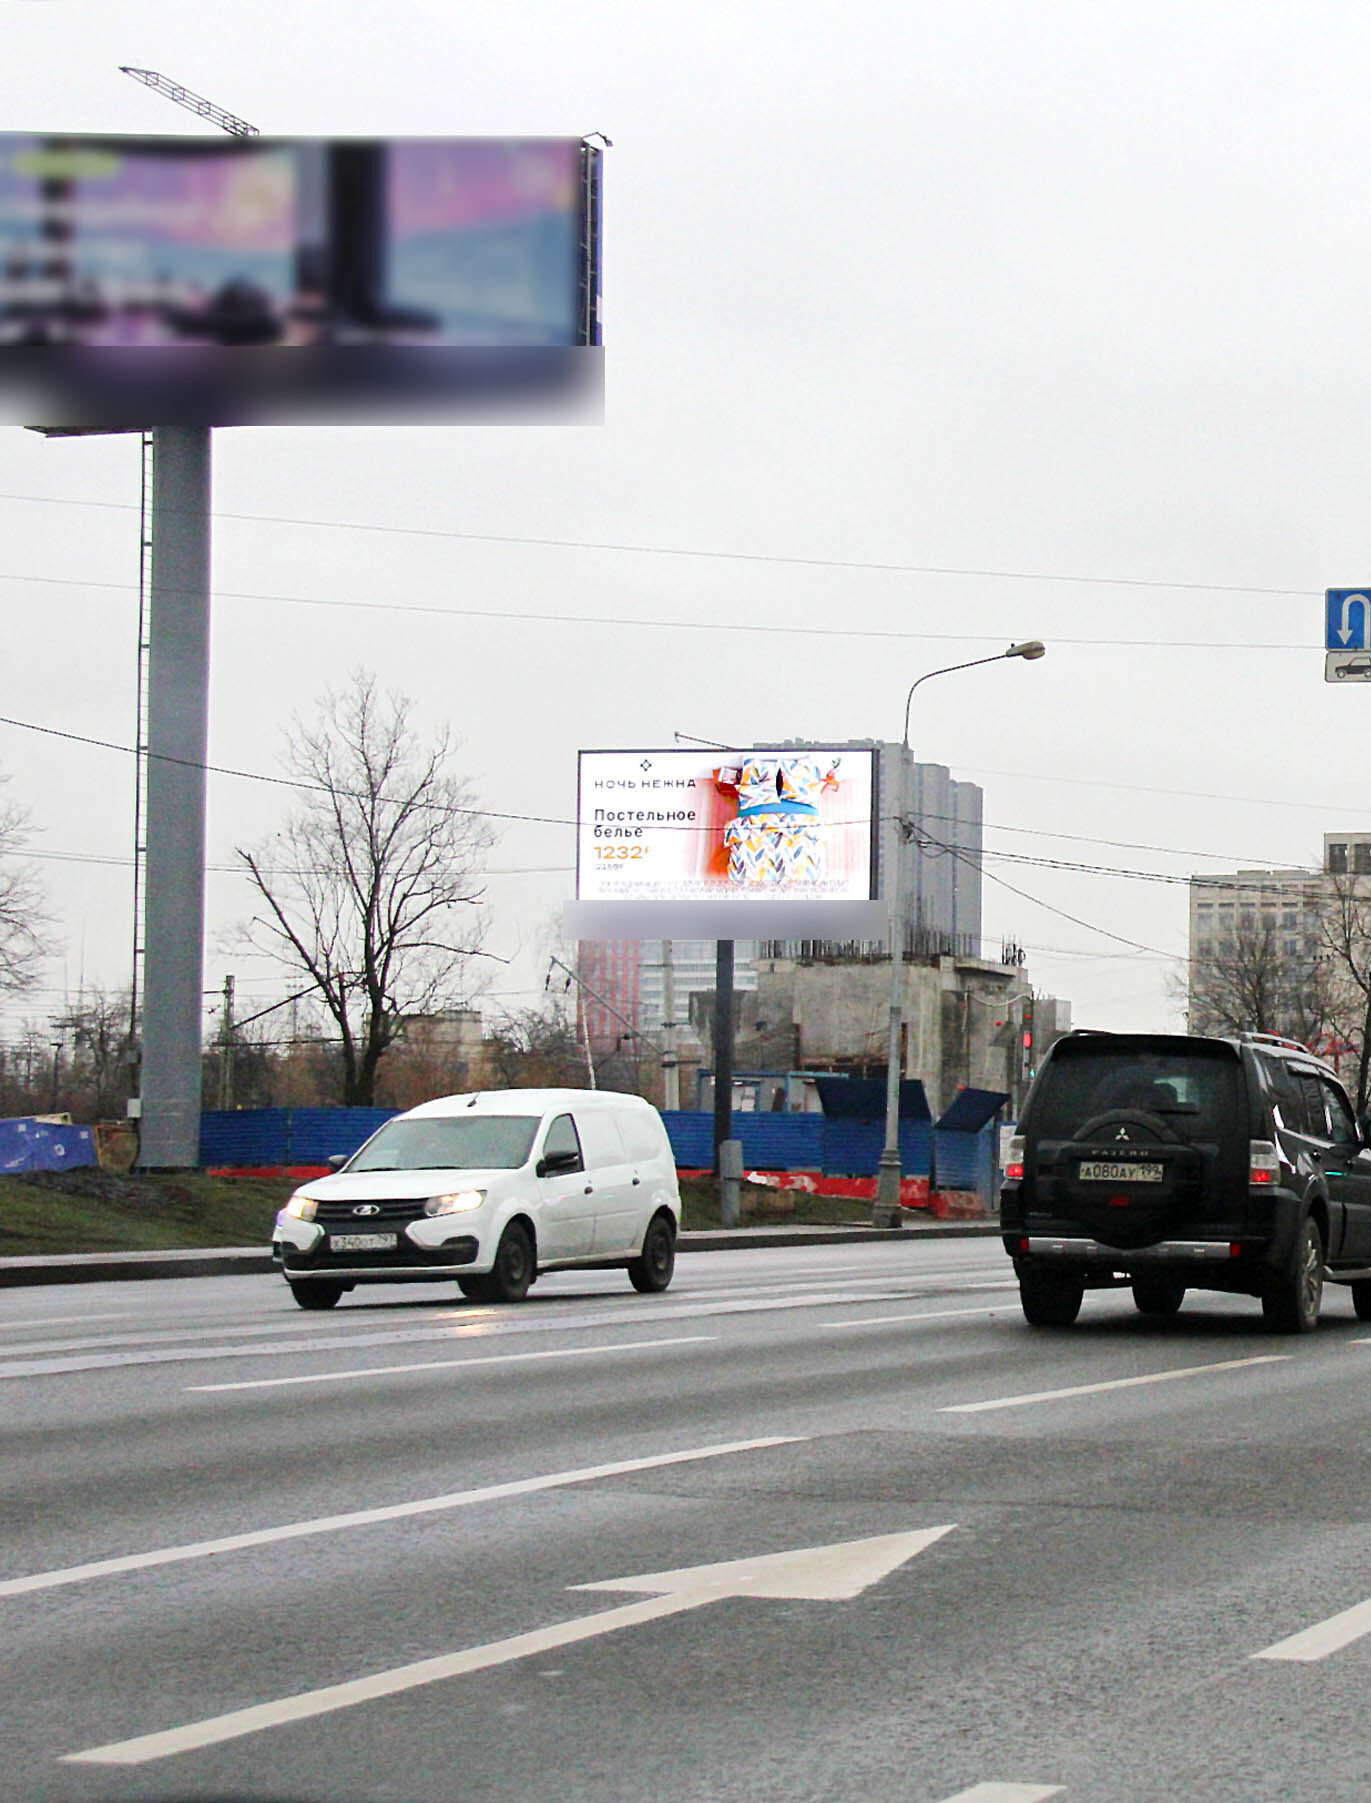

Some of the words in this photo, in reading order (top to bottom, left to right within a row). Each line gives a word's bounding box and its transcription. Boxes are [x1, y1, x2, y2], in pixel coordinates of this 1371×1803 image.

[595, 779, 636, 789] НОЧЬ
[642, 779, 697, 789] НЕЖНА
[594, 809, 696, 821] Постельное
[594, 824, 643, 838] белье
